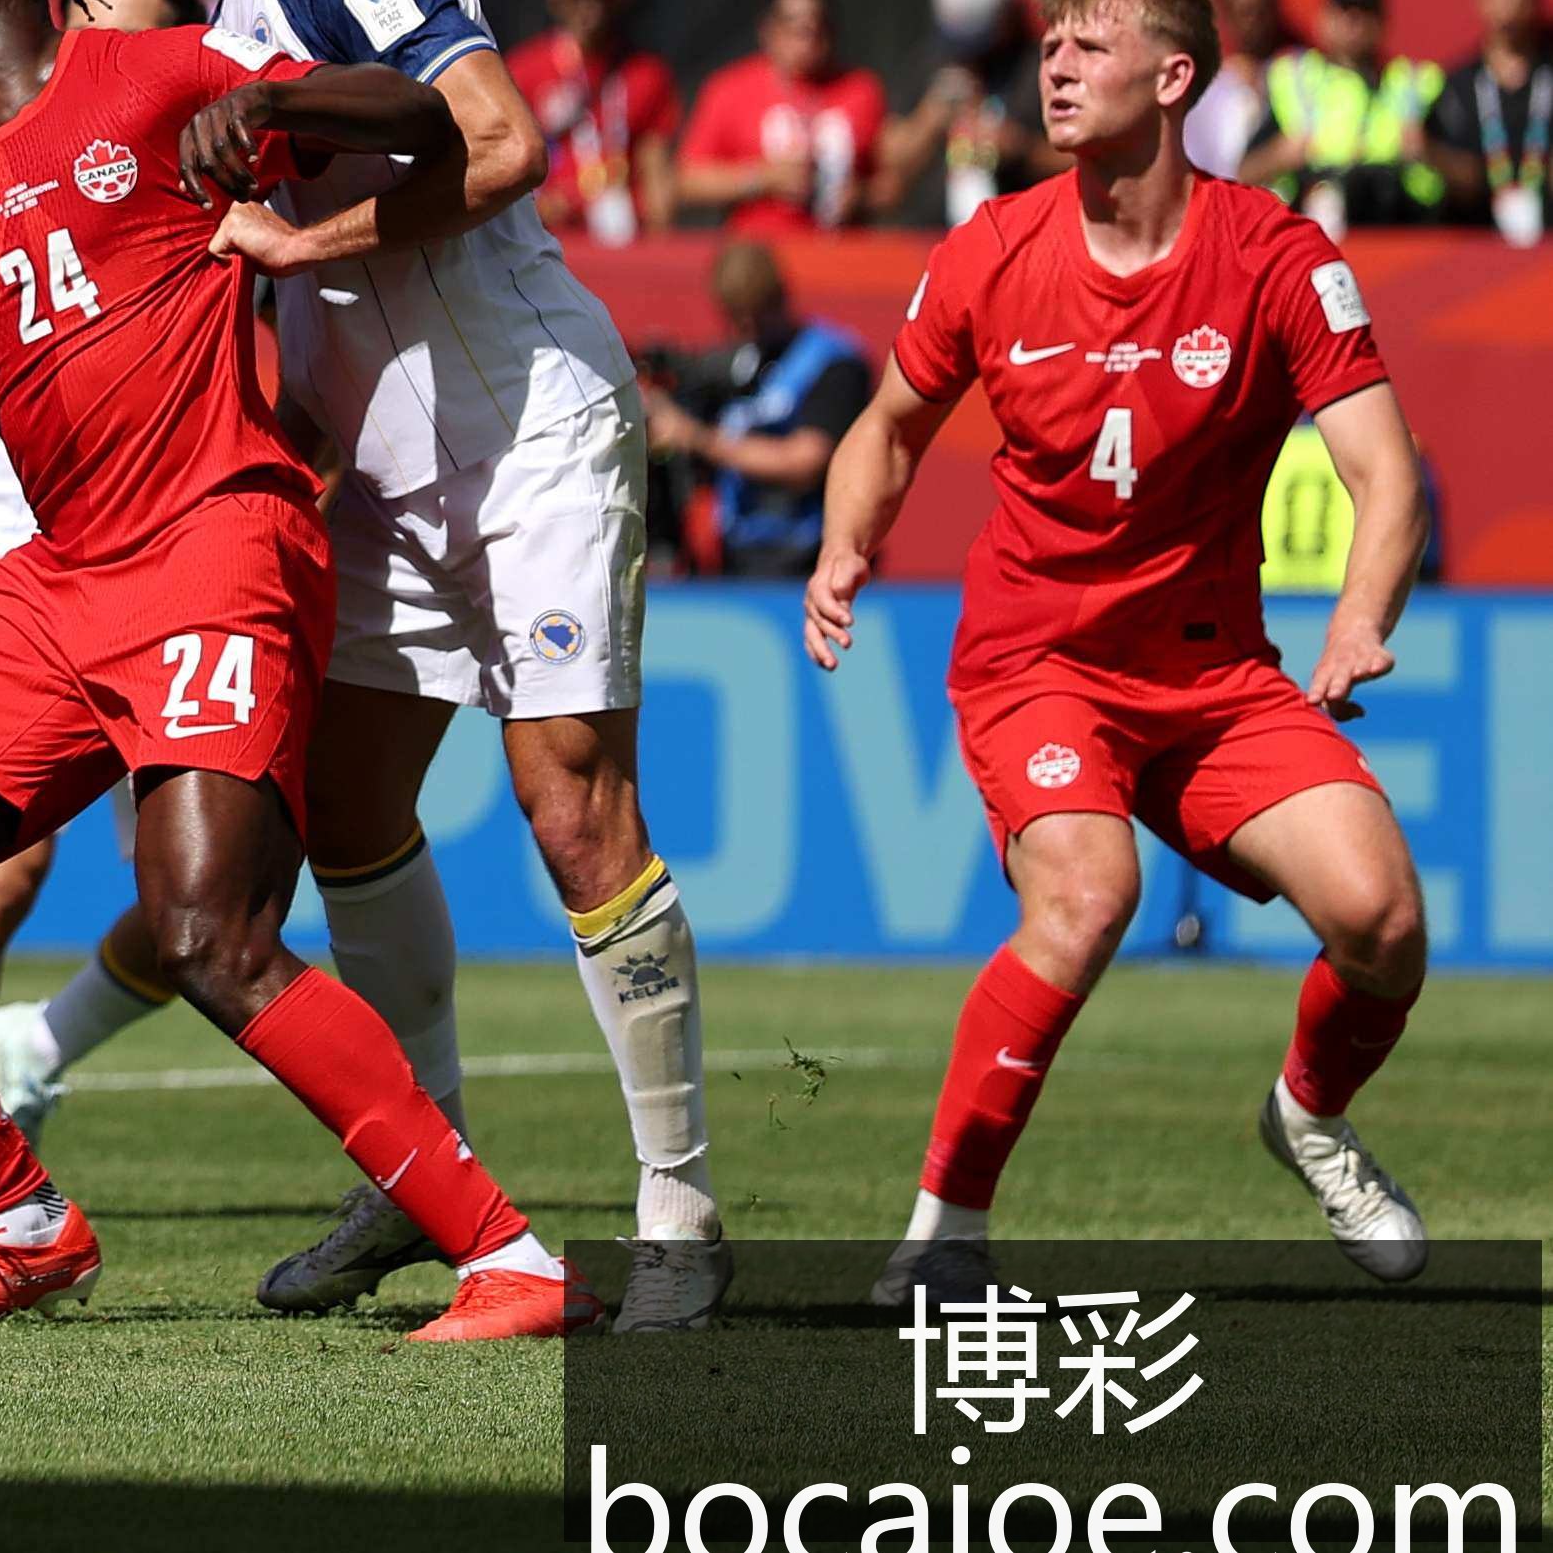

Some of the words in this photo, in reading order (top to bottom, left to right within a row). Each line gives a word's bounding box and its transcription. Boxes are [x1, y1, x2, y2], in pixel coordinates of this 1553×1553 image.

[77, 161, 137, 184] CANADA
[1090, 408, 1138, 500] 4
[160, 633, 256, 724] 24
[618, 975, 681, 1005] KELME
